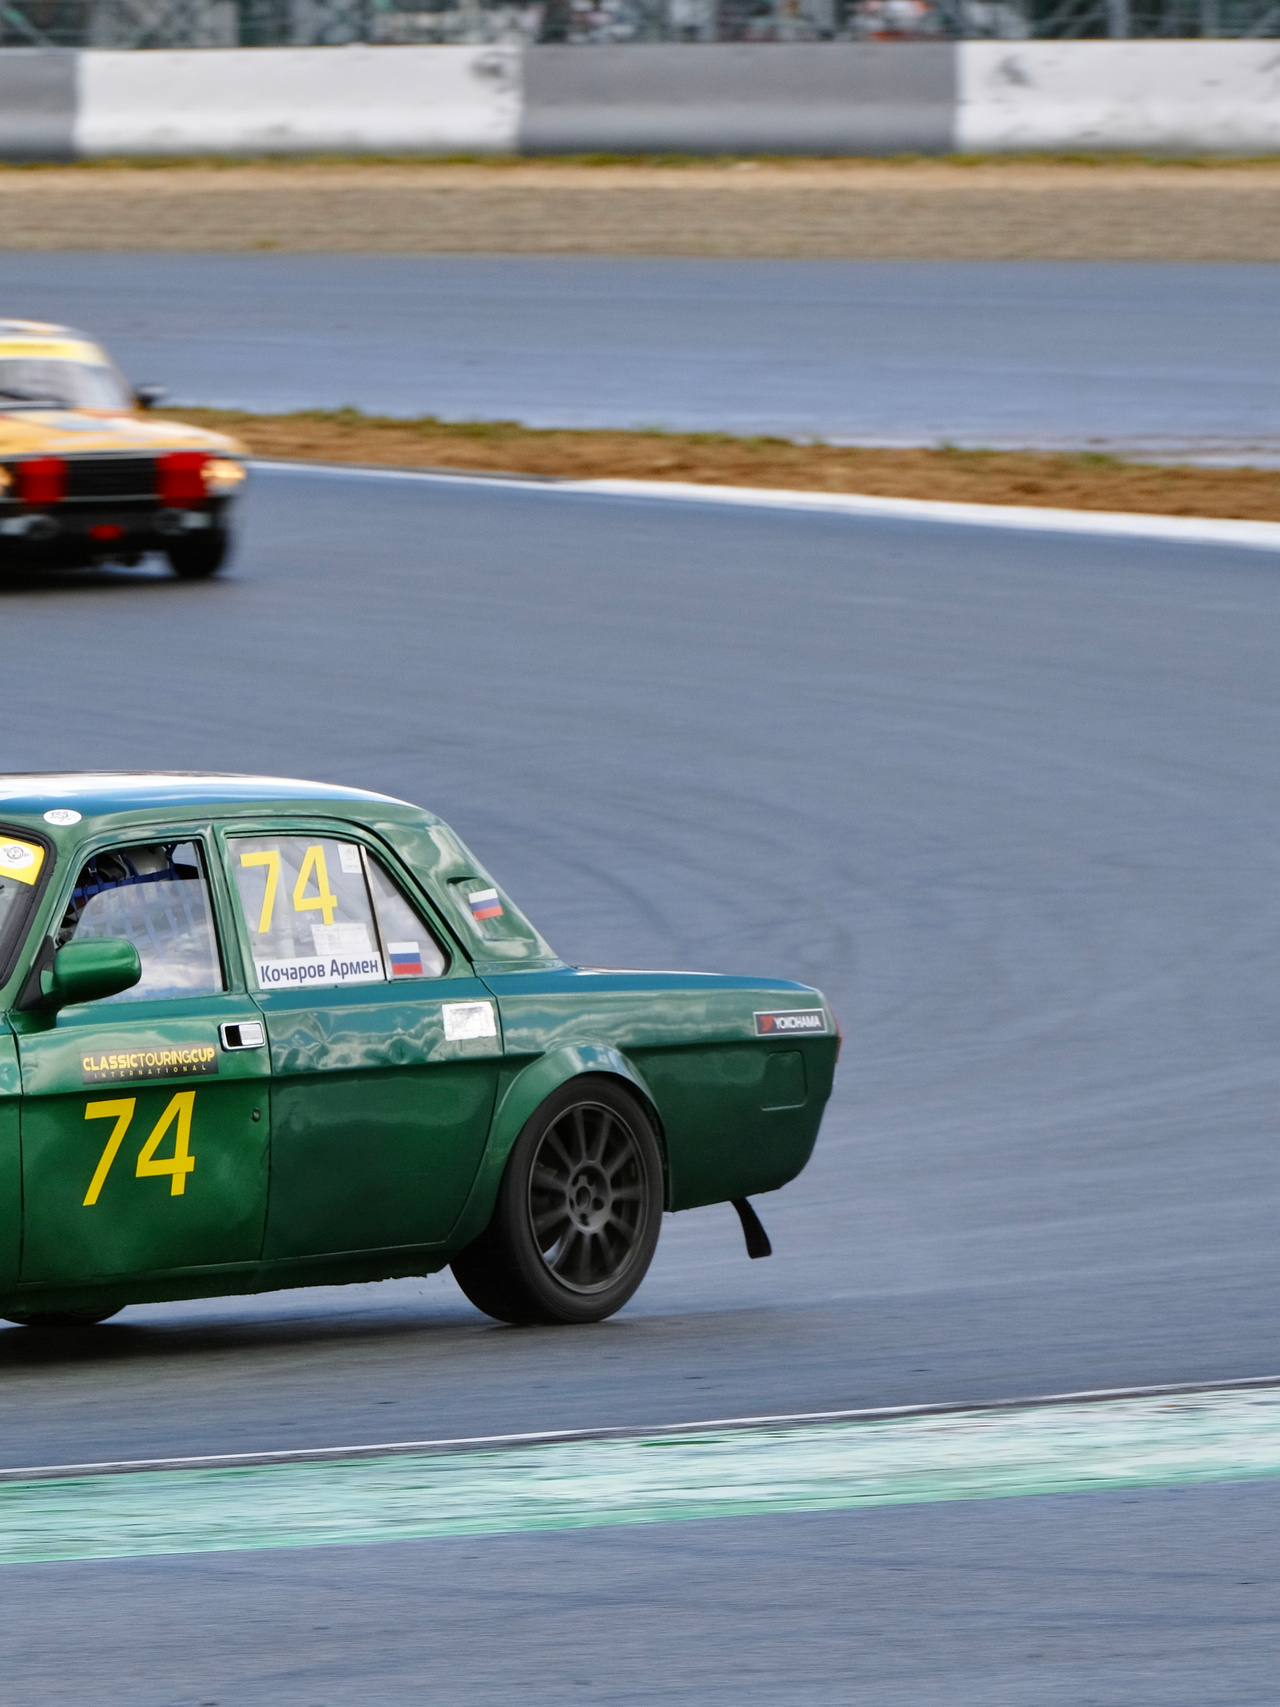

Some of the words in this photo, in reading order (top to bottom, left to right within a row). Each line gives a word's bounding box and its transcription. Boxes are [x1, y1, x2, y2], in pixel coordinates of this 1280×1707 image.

[240, 845, 338, 933] 74
[260, 963, 326, 983] Кочаров
[330, 959, 379, 979] Армен
[774, 1015, 822, 1029] YOKOHAMA
[82, 1047, 216, 1071] CLASSICTOURINGCUP
[94, 1064, 207, 1079] INTERNATIONAL
[82, 1090, 196, 1206] 74
